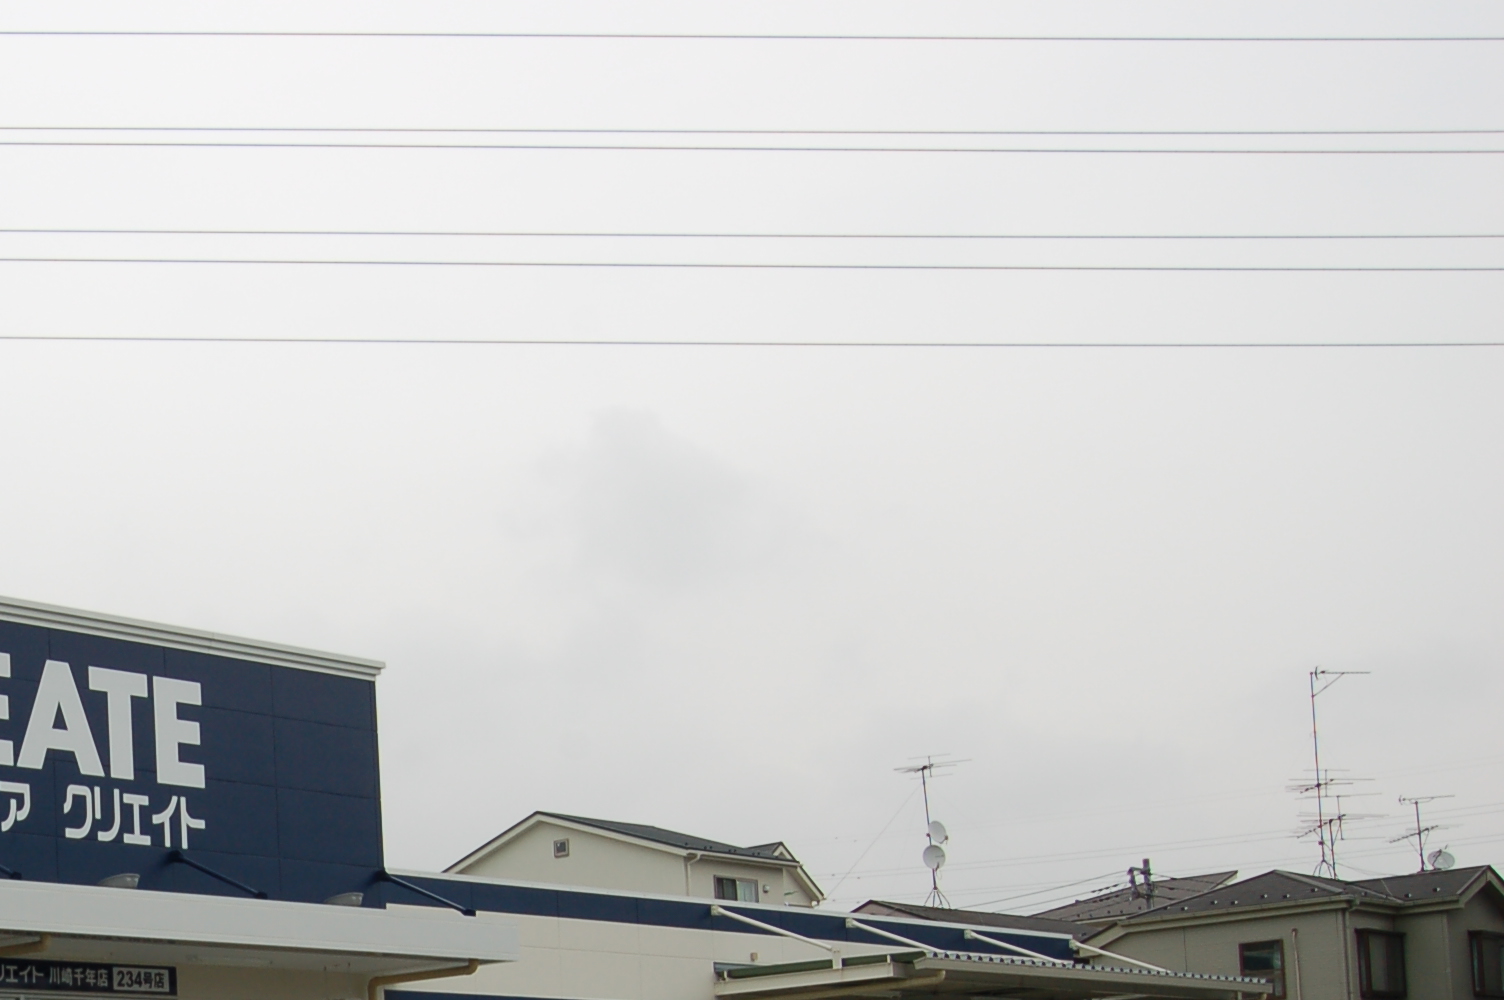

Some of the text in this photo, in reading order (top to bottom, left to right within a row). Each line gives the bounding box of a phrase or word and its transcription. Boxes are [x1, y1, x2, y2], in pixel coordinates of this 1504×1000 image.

[63, 784, 206, 849] クリエイト
[116, 970, 165, 989] 234号店
